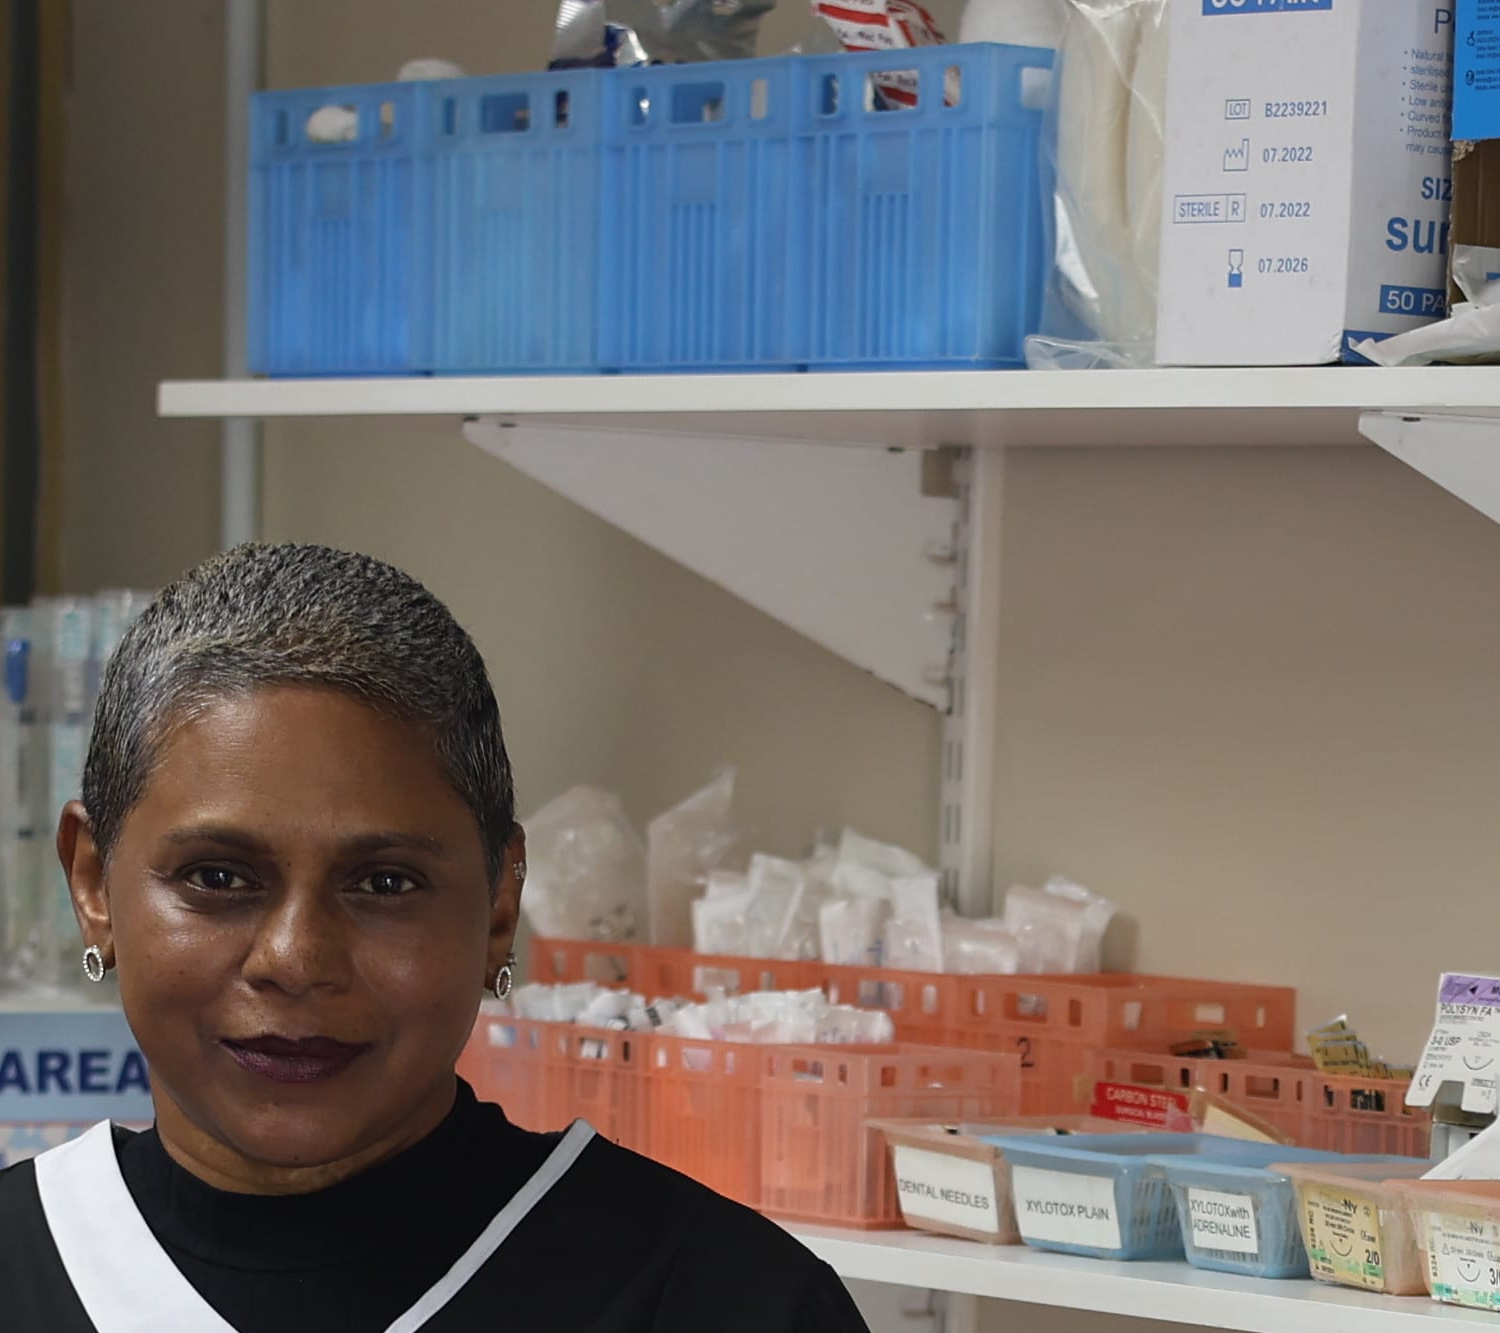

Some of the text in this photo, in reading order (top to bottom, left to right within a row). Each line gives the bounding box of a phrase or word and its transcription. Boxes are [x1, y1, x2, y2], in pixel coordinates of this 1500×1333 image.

[1229, 101, 1327, 117] LOT B2239221
[1263, 147, 1313, 163] 07.2022
[1179, 201, 1310, 218] STERILE R 07.2022
[1258, 258, 1308, 273] 07.2026
[1387, 292, 1413, 310] 50
[1440, 1003, 1478, 1016] POLYSYN
[1105, 1087, 1146, 1107] CARBON
[901, 1179, 989, 1210] DENTAL NEEDLES
[1026, 1199, 1109, 1221] XYLOTOX PLAIN
[1193, 1219, 1251, 1239] ADRENALINE
[1365, 1249, 1380, 1266] 2/0
